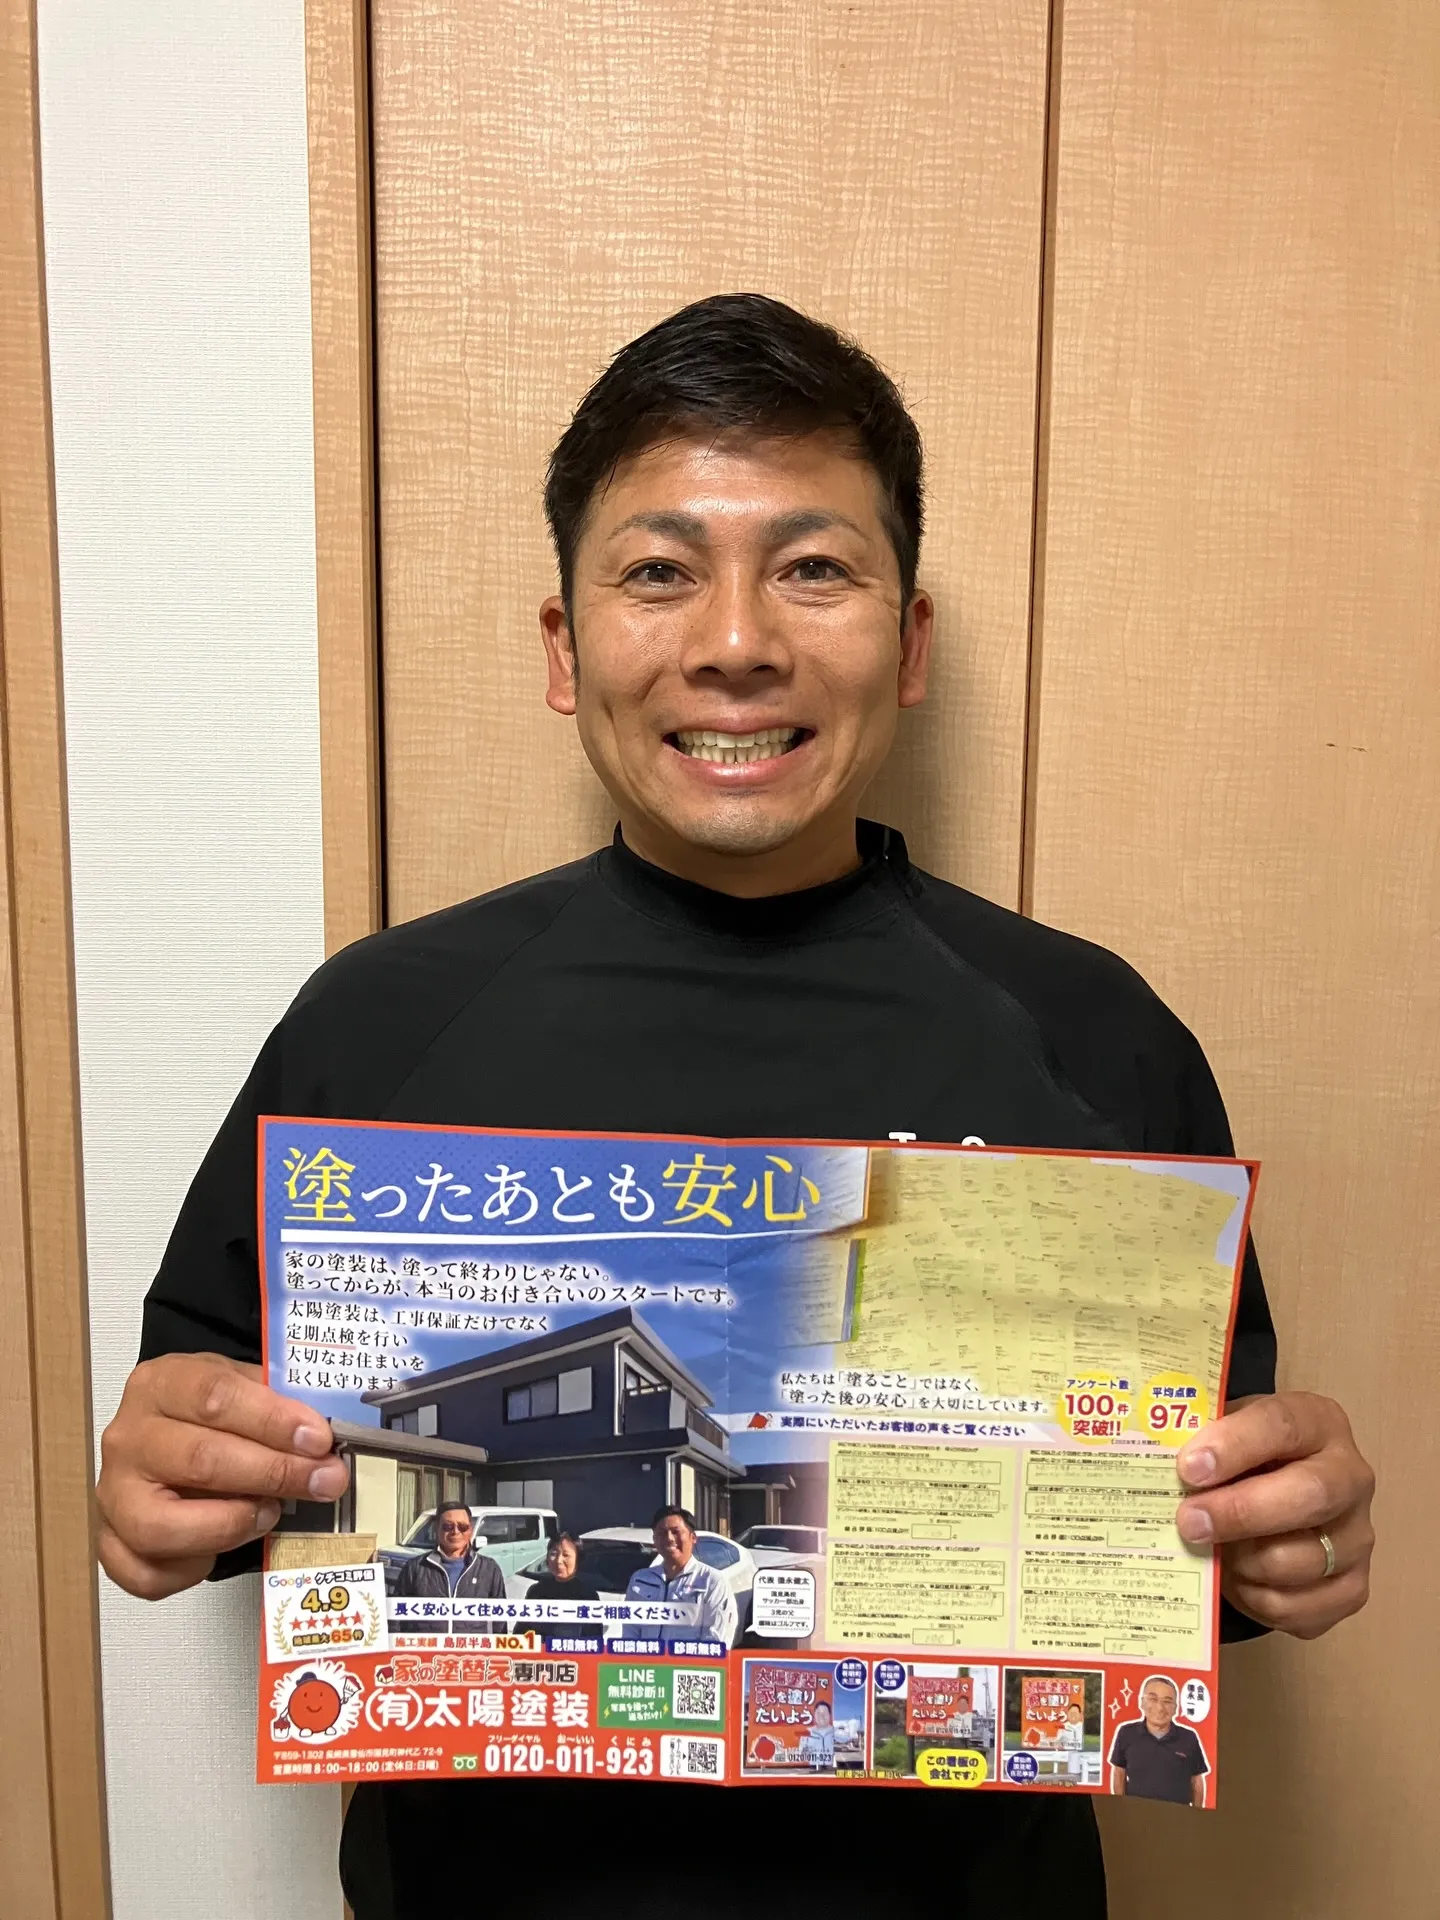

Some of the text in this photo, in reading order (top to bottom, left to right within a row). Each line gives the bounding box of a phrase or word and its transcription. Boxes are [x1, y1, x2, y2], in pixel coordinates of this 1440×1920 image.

[282, 1147, 821, 1227] 塗ったあとも安心
[285, 1250, 611, 1283] 家の塗装は、塗って終わりじゃない。
[286, 1271, 737, 1307] 塗ってからが、本当のお付き合いのスタートです。
[287, 1300, 549, 1333] 太陽塗装は、工事保証だけでなく
[286, 1322, 408, 1347] 定期点検を行い
[286, 1345, 425, 1372] 大切なお住まいを
[286, 1368, 407, 1392] 長く見守ります。
[780, 1371, 979, 1393] 私たちは「塗ること」ではなく、
[1066, 1379, 1129, 1390] アンケート数
[780, 1388, 1050, 1415] 「塗った後の安心」を大切にしています。
[1152, 1387, 1197, 1398] 平均点数
[1065, 1394, 1129, 1416] 100件
[780, 1415, 1026, 1437] 実際にいただいたお客様の声をご覧ください
[1150, 1404, 1199, 1430] 97点
[268, 1573, 312, 1588] Google
[301, 1586, 350, 1613] 4.9
[394, 1631, 536, 1650] 施工実績 島原半島 NO.1
[612, 1640, 660, 1654] 相談無料
[673, 1642, 723, 1656] 診断無料
[392, 1655, 577, 1686] 家の塗替え専門店
[618, 1668, 656, 1683] LINE
[365, 1687, 590, 1732] (有)太陽塗装
[755, 1707, 813, 1725] たいよう
[487, 1734, 541, 1744] フリーダイヤル
[484, 1744, 654, 1776] 0120-011-923
[926, 1755, 979, 1767] この看板の
